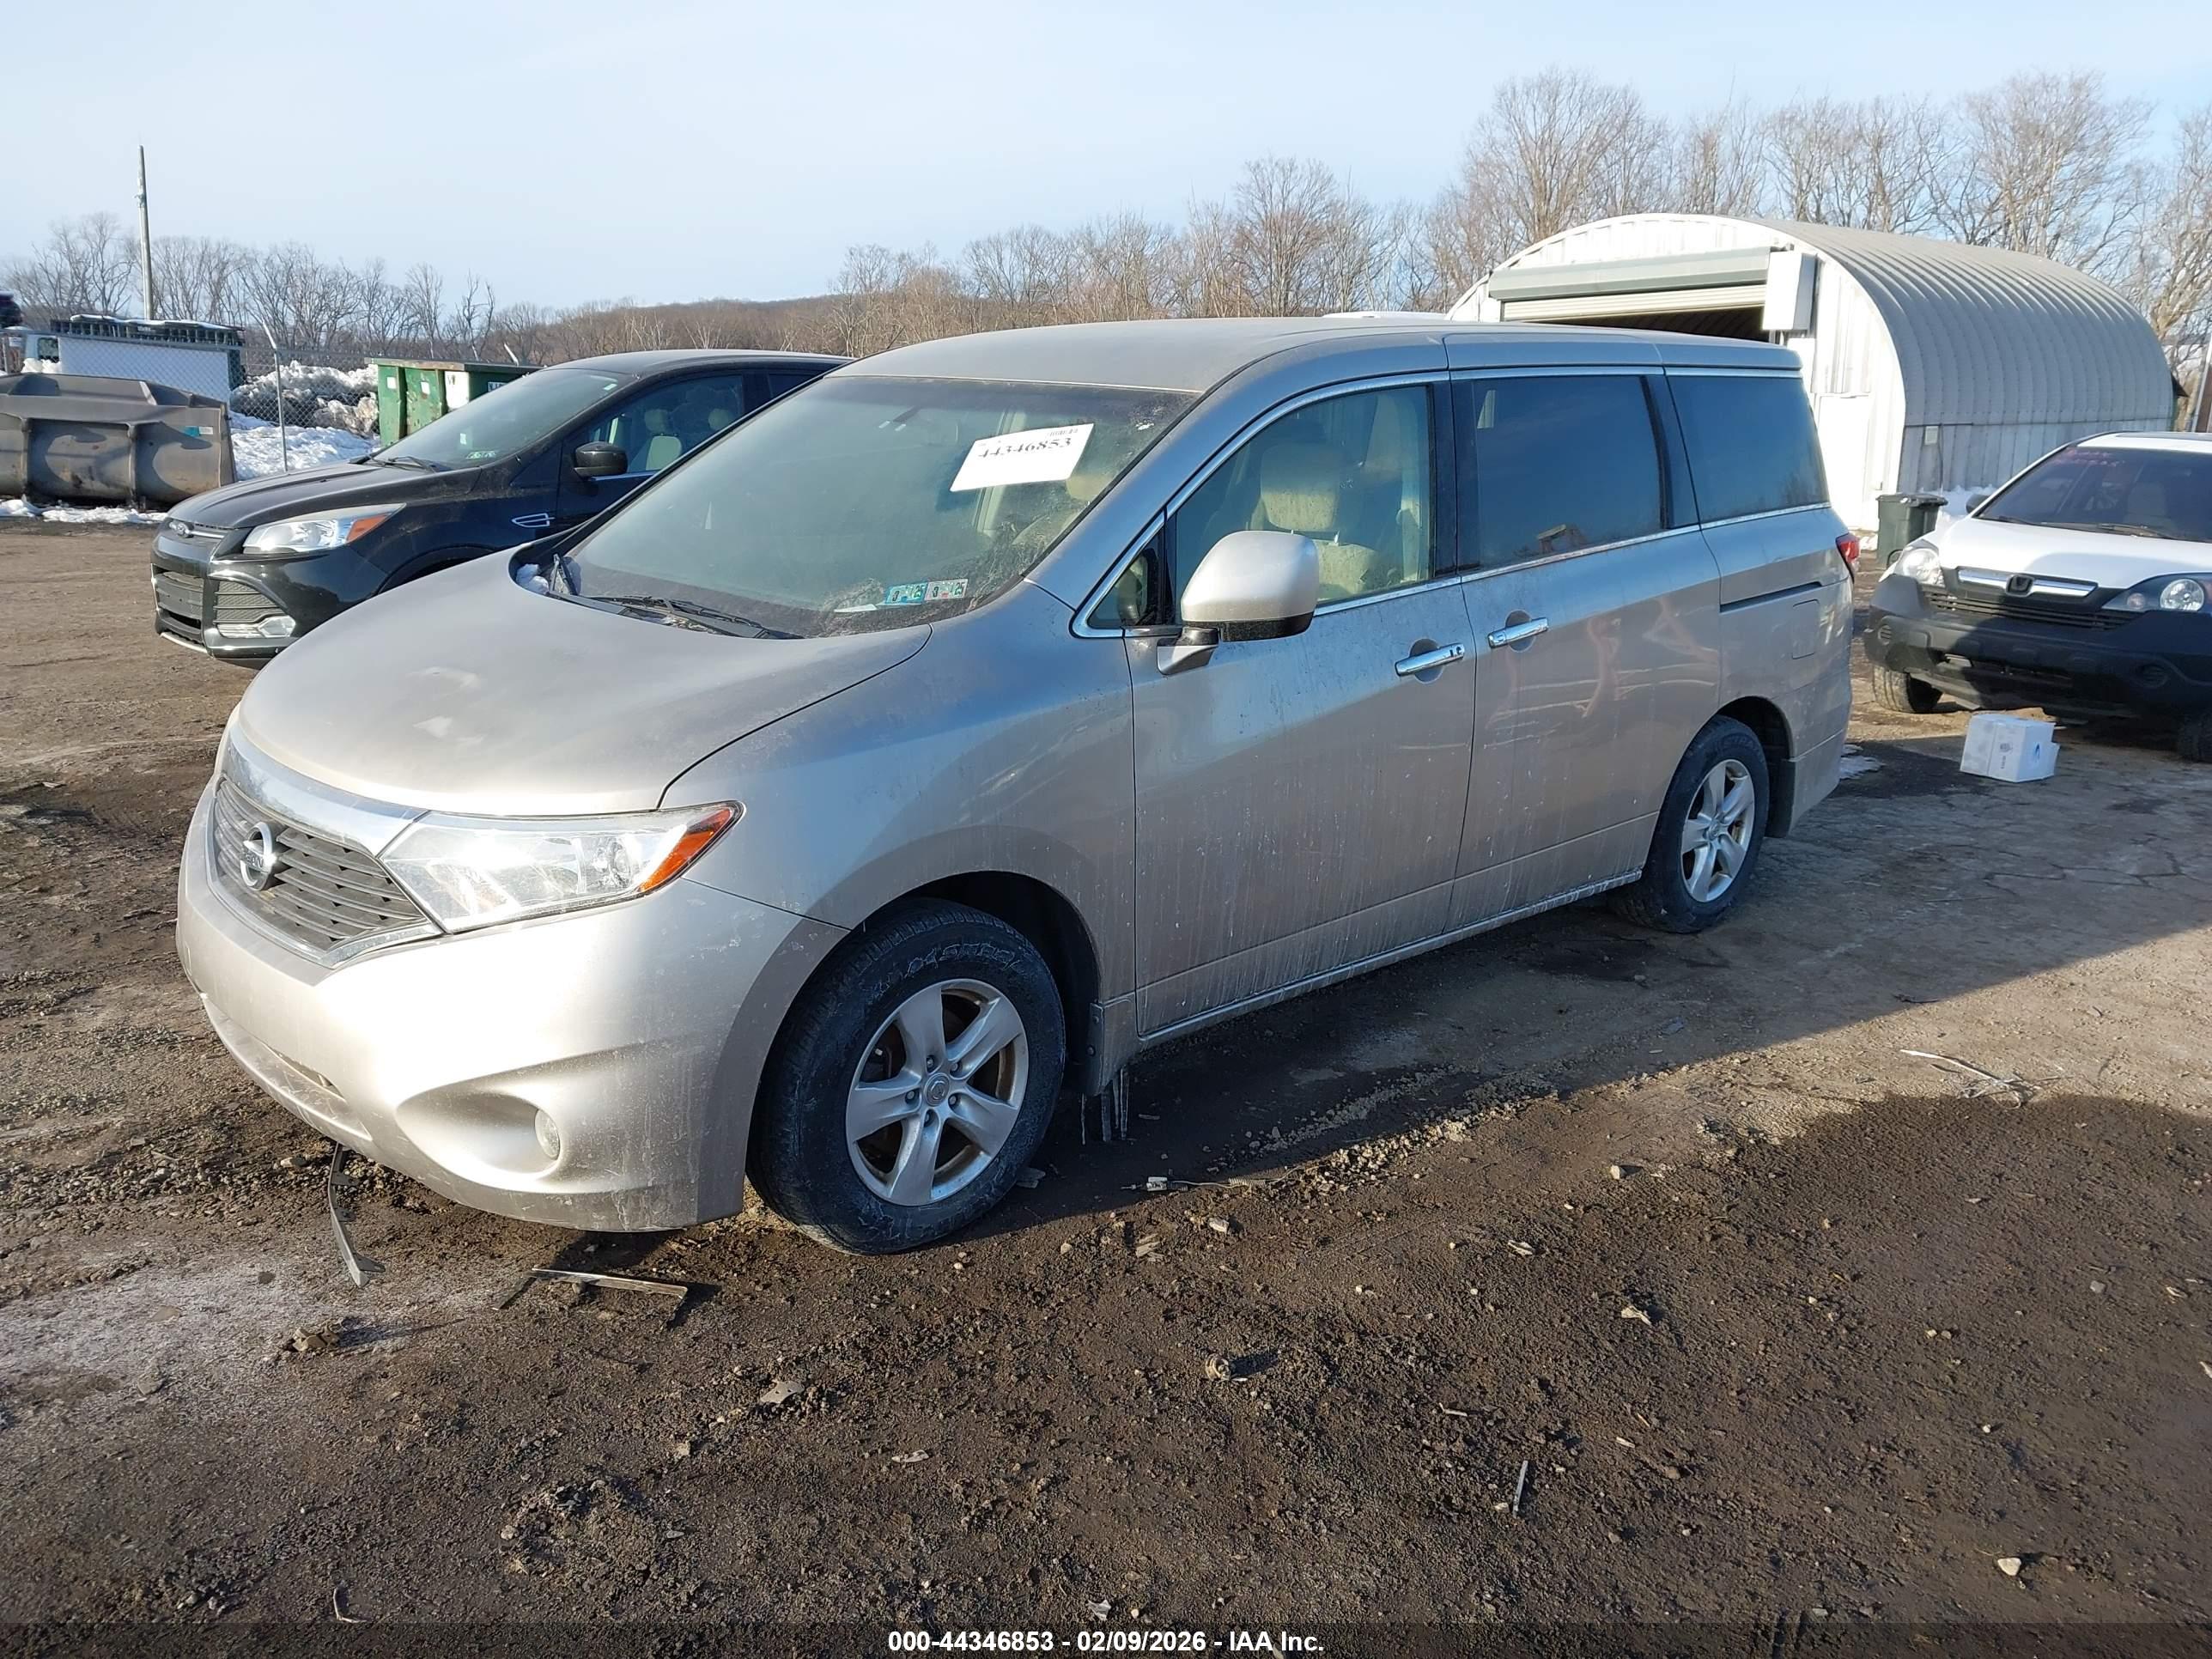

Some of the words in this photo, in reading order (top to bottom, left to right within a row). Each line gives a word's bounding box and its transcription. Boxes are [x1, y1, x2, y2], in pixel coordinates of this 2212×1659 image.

[978, 438, 1072, 458] 44346853
[914, 585, 926, 599] 25
[954, 582, 966, 595] 25
